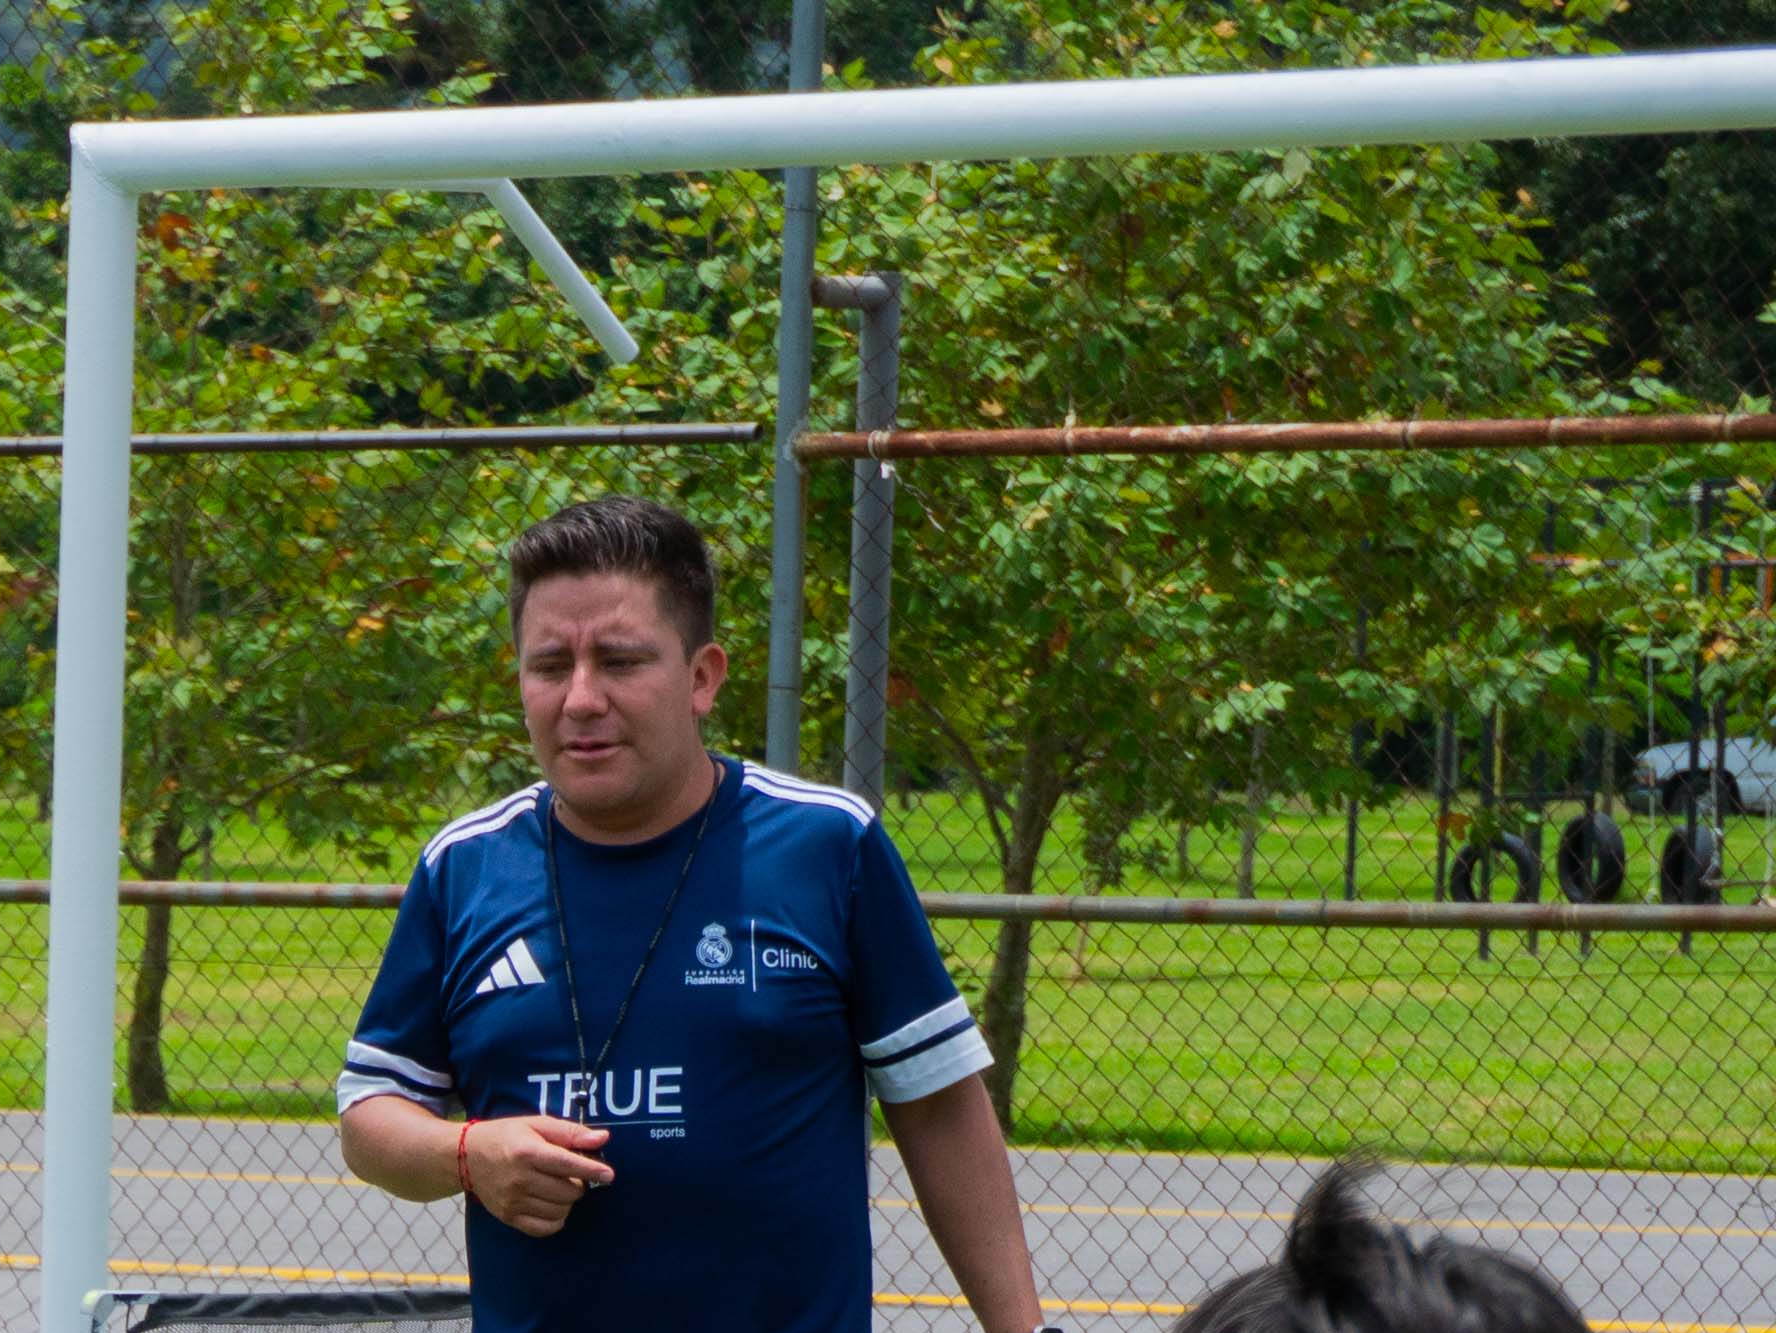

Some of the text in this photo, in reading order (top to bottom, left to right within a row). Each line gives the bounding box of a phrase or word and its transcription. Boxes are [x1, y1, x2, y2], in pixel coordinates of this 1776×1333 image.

[762, 948, 818, 969] Clinic
[527, 1066, 683, 1117] TRUE
[650, 1127, 686, 1140] sports
